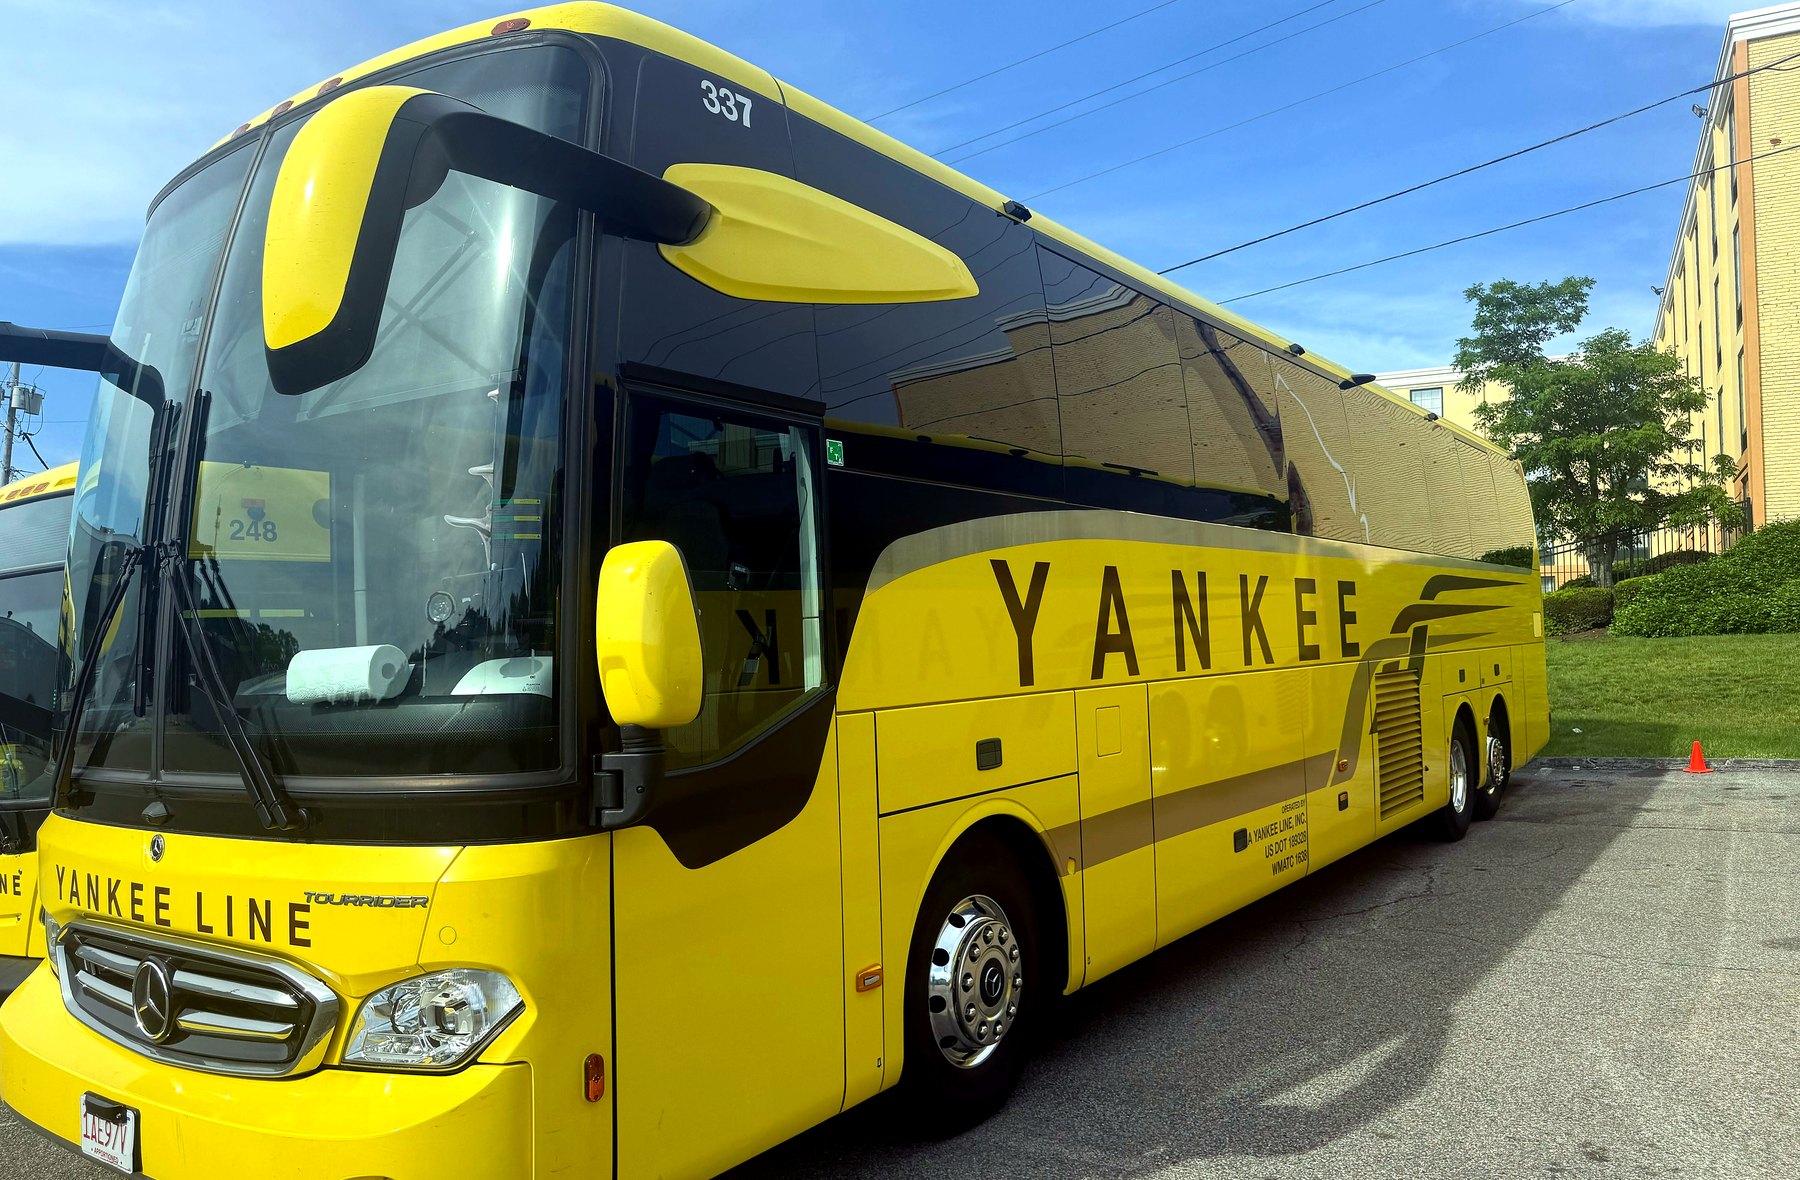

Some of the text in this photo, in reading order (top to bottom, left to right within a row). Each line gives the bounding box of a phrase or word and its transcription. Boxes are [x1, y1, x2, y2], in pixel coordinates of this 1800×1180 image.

[700, 79, 752, 128] 337
[229, 519, 278, 542] 248
[989, 558, 1361, 687] YANKEE
[1281, 800, 1300, 814] OPERATED
[1247, 812, 1306, 846] A YANKEE LINE, INC.
[1264, 843, 1273, 858] US
[1275, 838, 1287, 854] DOT
[1271, 849, 1307, 875] WMATC 1638
[55, 864, 311, 948] YANKEE LINE
[303, 891, 429, 909] TOURRIDER
